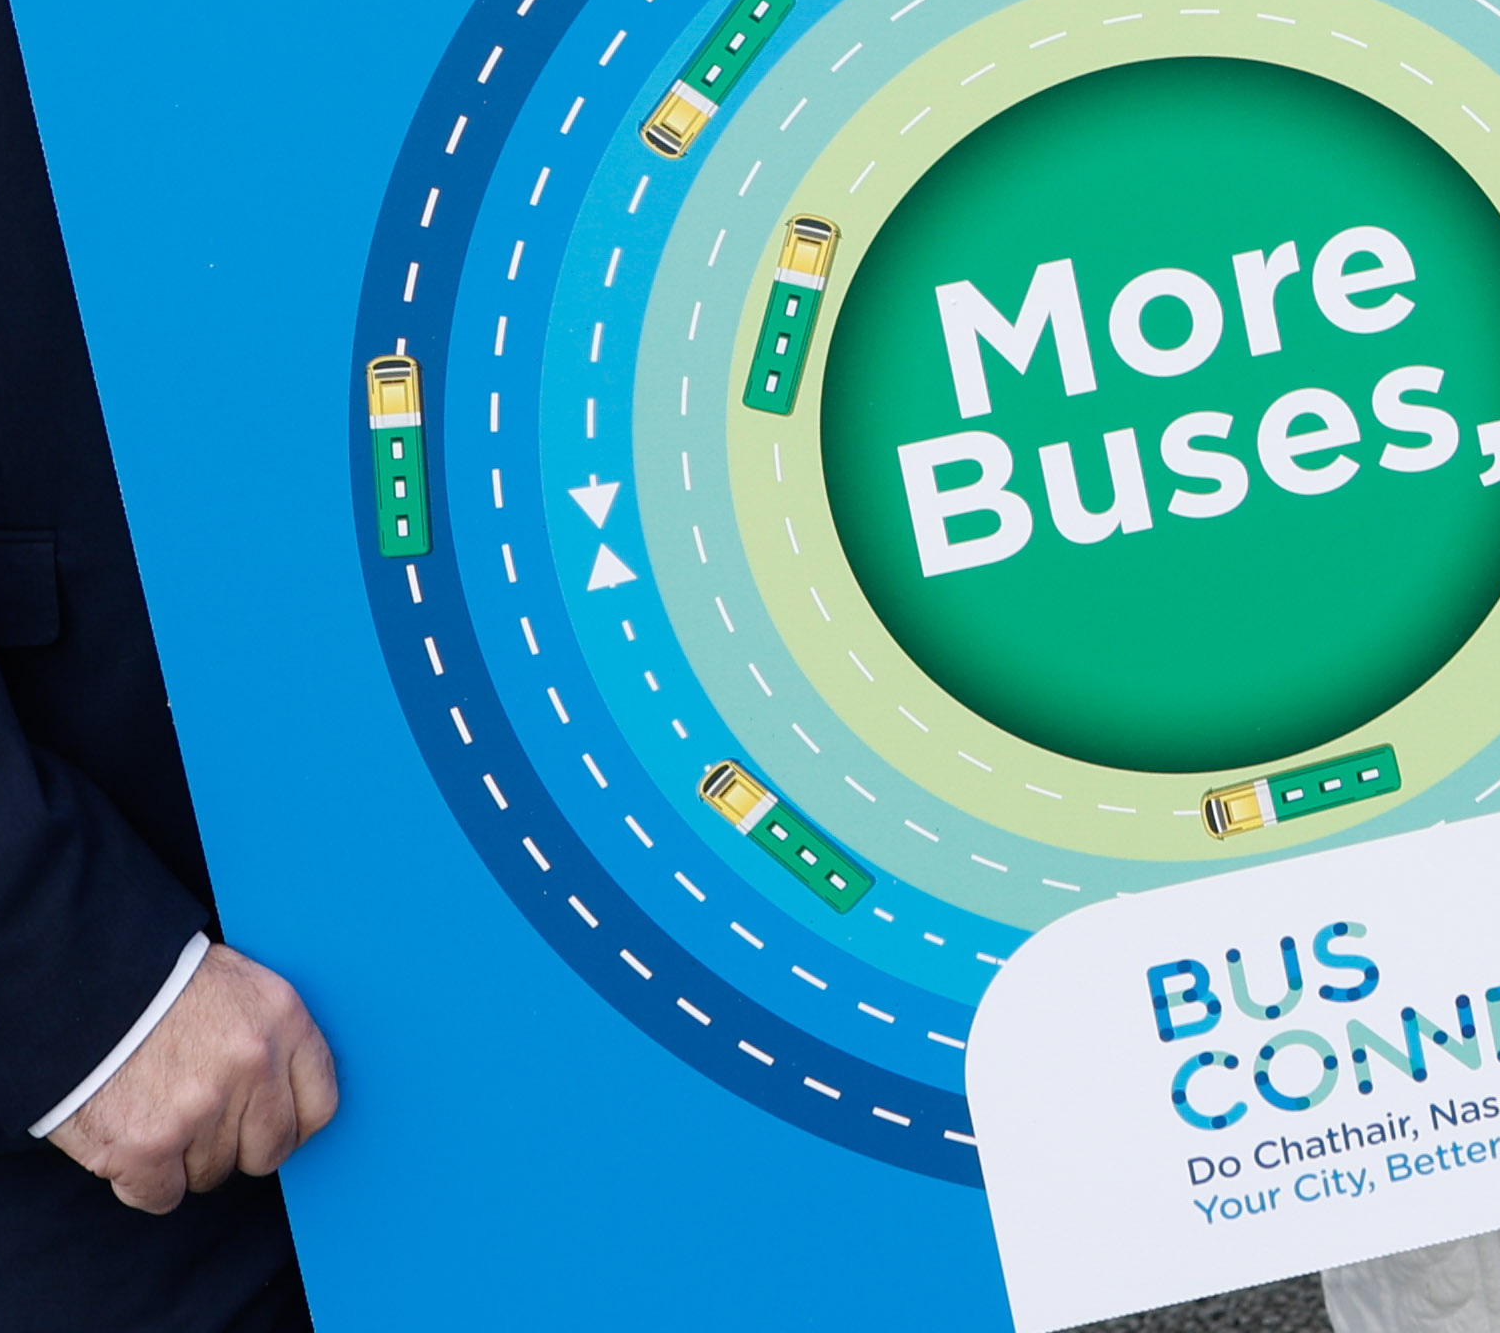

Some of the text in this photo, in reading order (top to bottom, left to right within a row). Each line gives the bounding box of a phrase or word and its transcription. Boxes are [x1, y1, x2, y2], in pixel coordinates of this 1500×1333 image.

[935, 225, 1417, 420] More
[1147, 921, 1380, 1043] BUS
[1187, 1155, 1242, 1186] Do
[1253, 1111, 1420, 1170] Chathair,
[1193, 1186, 1281, 1225] Your
[1293, 1167, 1376, 1203] City,
